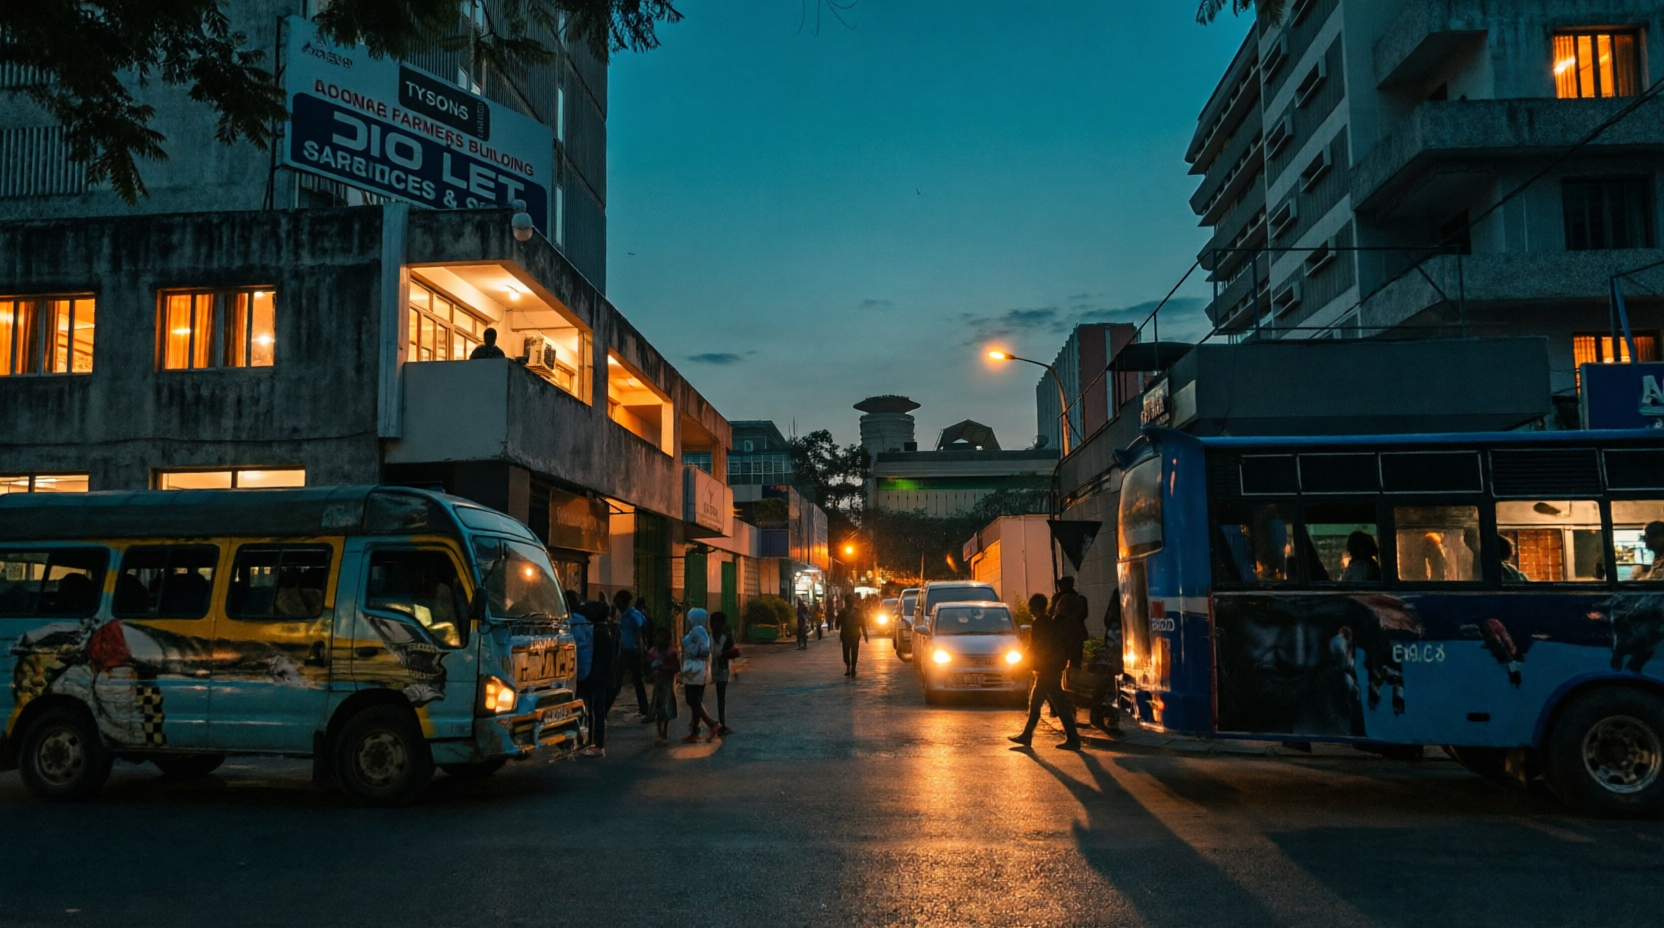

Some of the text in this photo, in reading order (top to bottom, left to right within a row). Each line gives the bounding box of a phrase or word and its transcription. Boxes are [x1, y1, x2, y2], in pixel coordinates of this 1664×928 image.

[405, 80, 469, 121] TYSONS
[442, 152, 525, 202] LET
[469, 140, 535, 177] BUILDING
[1642, 374, 1664, 405] A
